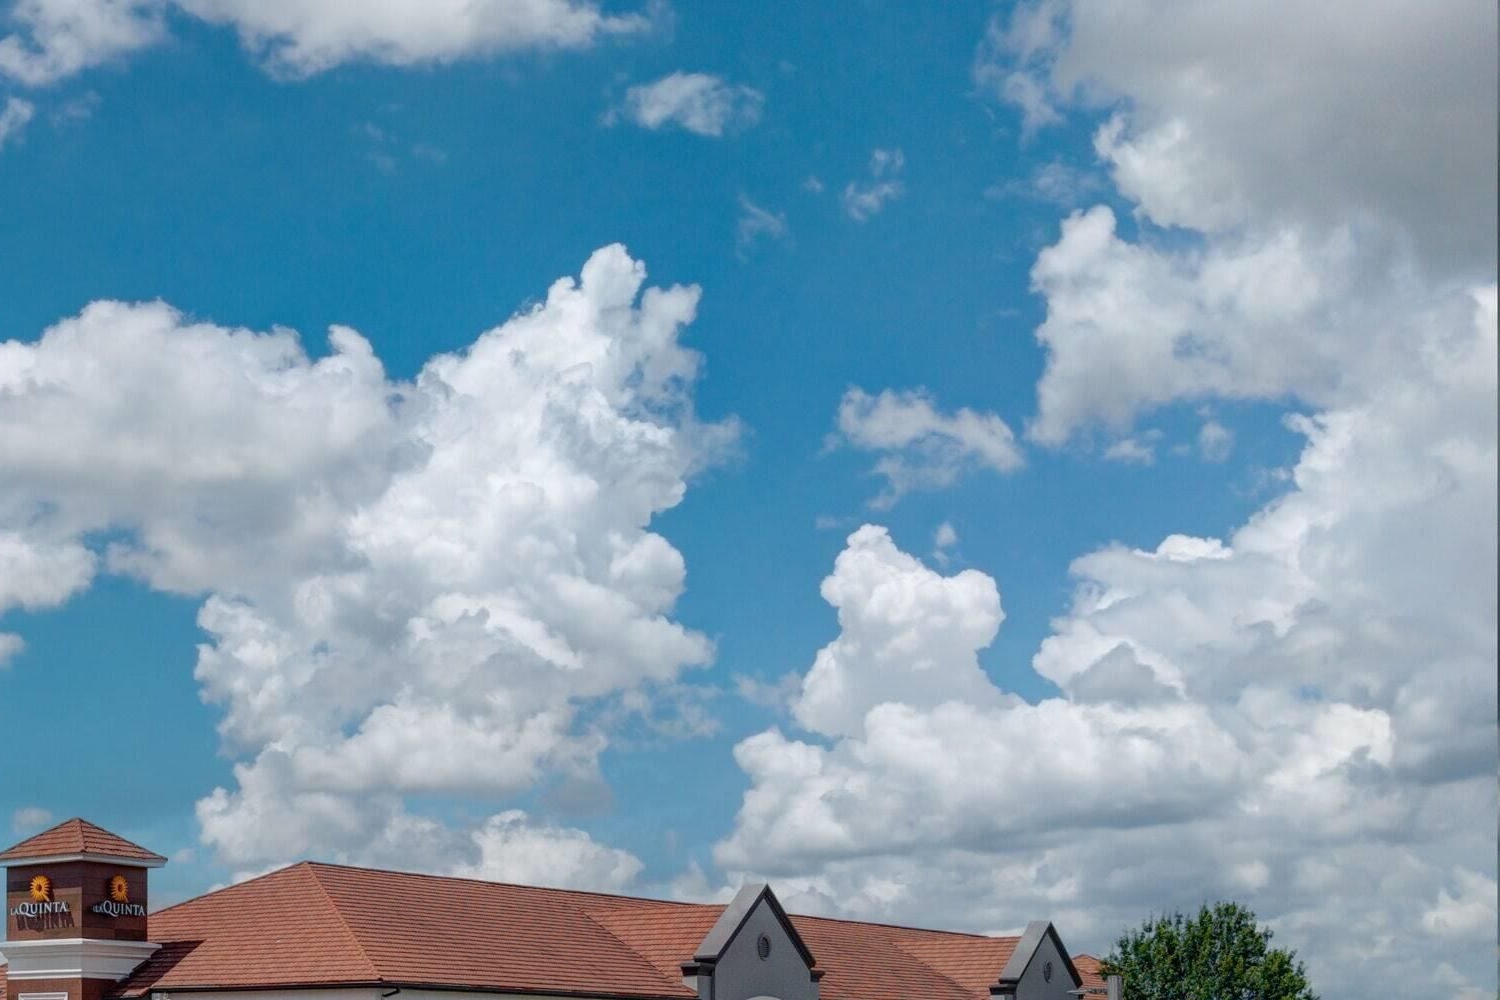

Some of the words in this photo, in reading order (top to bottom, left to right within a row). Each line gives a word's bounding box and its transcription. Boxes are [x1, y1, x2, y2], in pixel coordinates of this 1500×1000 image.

[10, 906, 19, 916] LA
[19, 900, 68, 917] QUINTA
[103, 900, 145, 917] QUINTA
